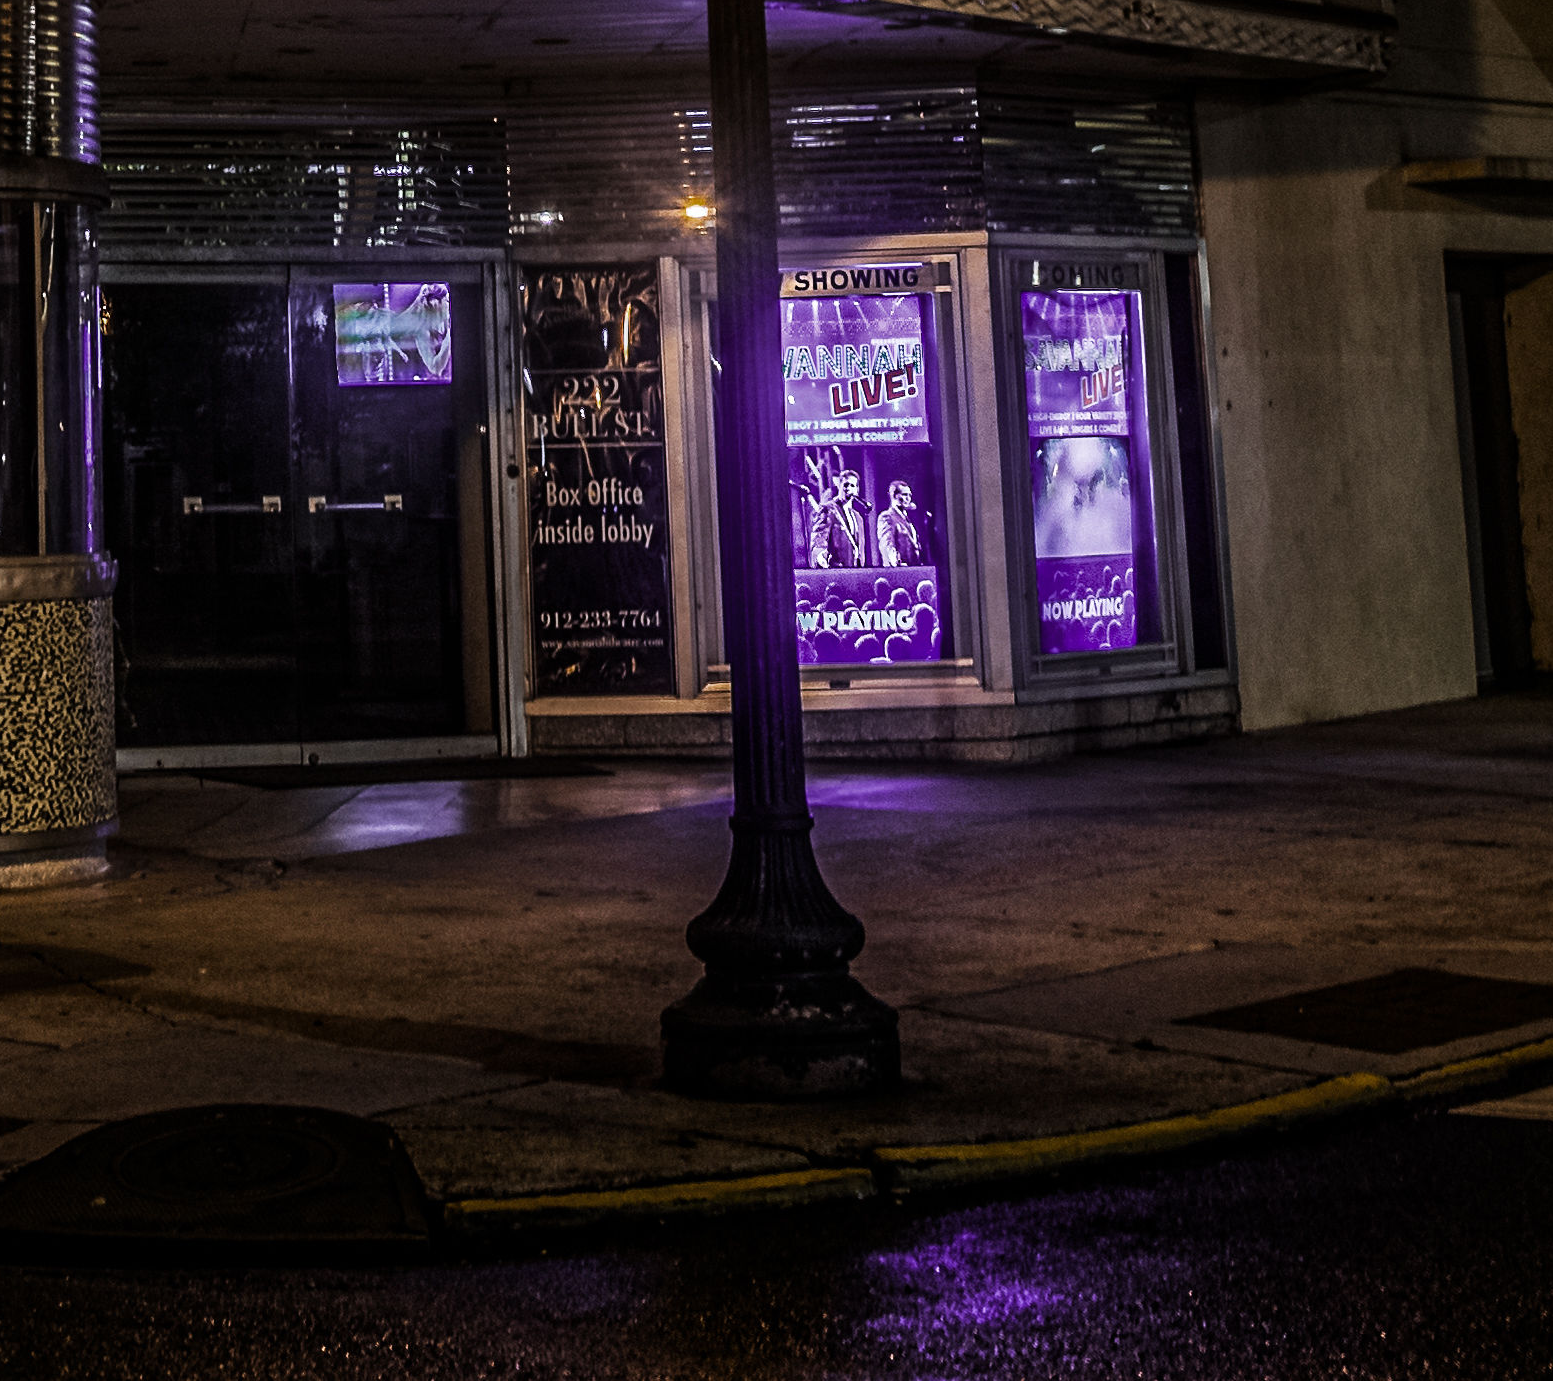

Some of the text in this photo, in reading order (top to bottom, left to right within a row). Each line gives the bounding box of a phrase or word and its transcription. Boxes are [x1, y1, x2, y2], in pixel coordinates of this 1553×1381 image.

[794, 269, 919, 291] SHOWING
[563, 374, 622, 405] 222
[830, 363, 918, 416] LIVE!
[533, 412, 608, 438] BULL
[546, 476, 643, 507] Box Office
[537, 514, 654, 549] inside lobby
[540, 609, 661, 629] 912-233-7764
[822, 609, 913, 632] PLAYING
[1042, 597, 1123, 621] NOW PLAYING
